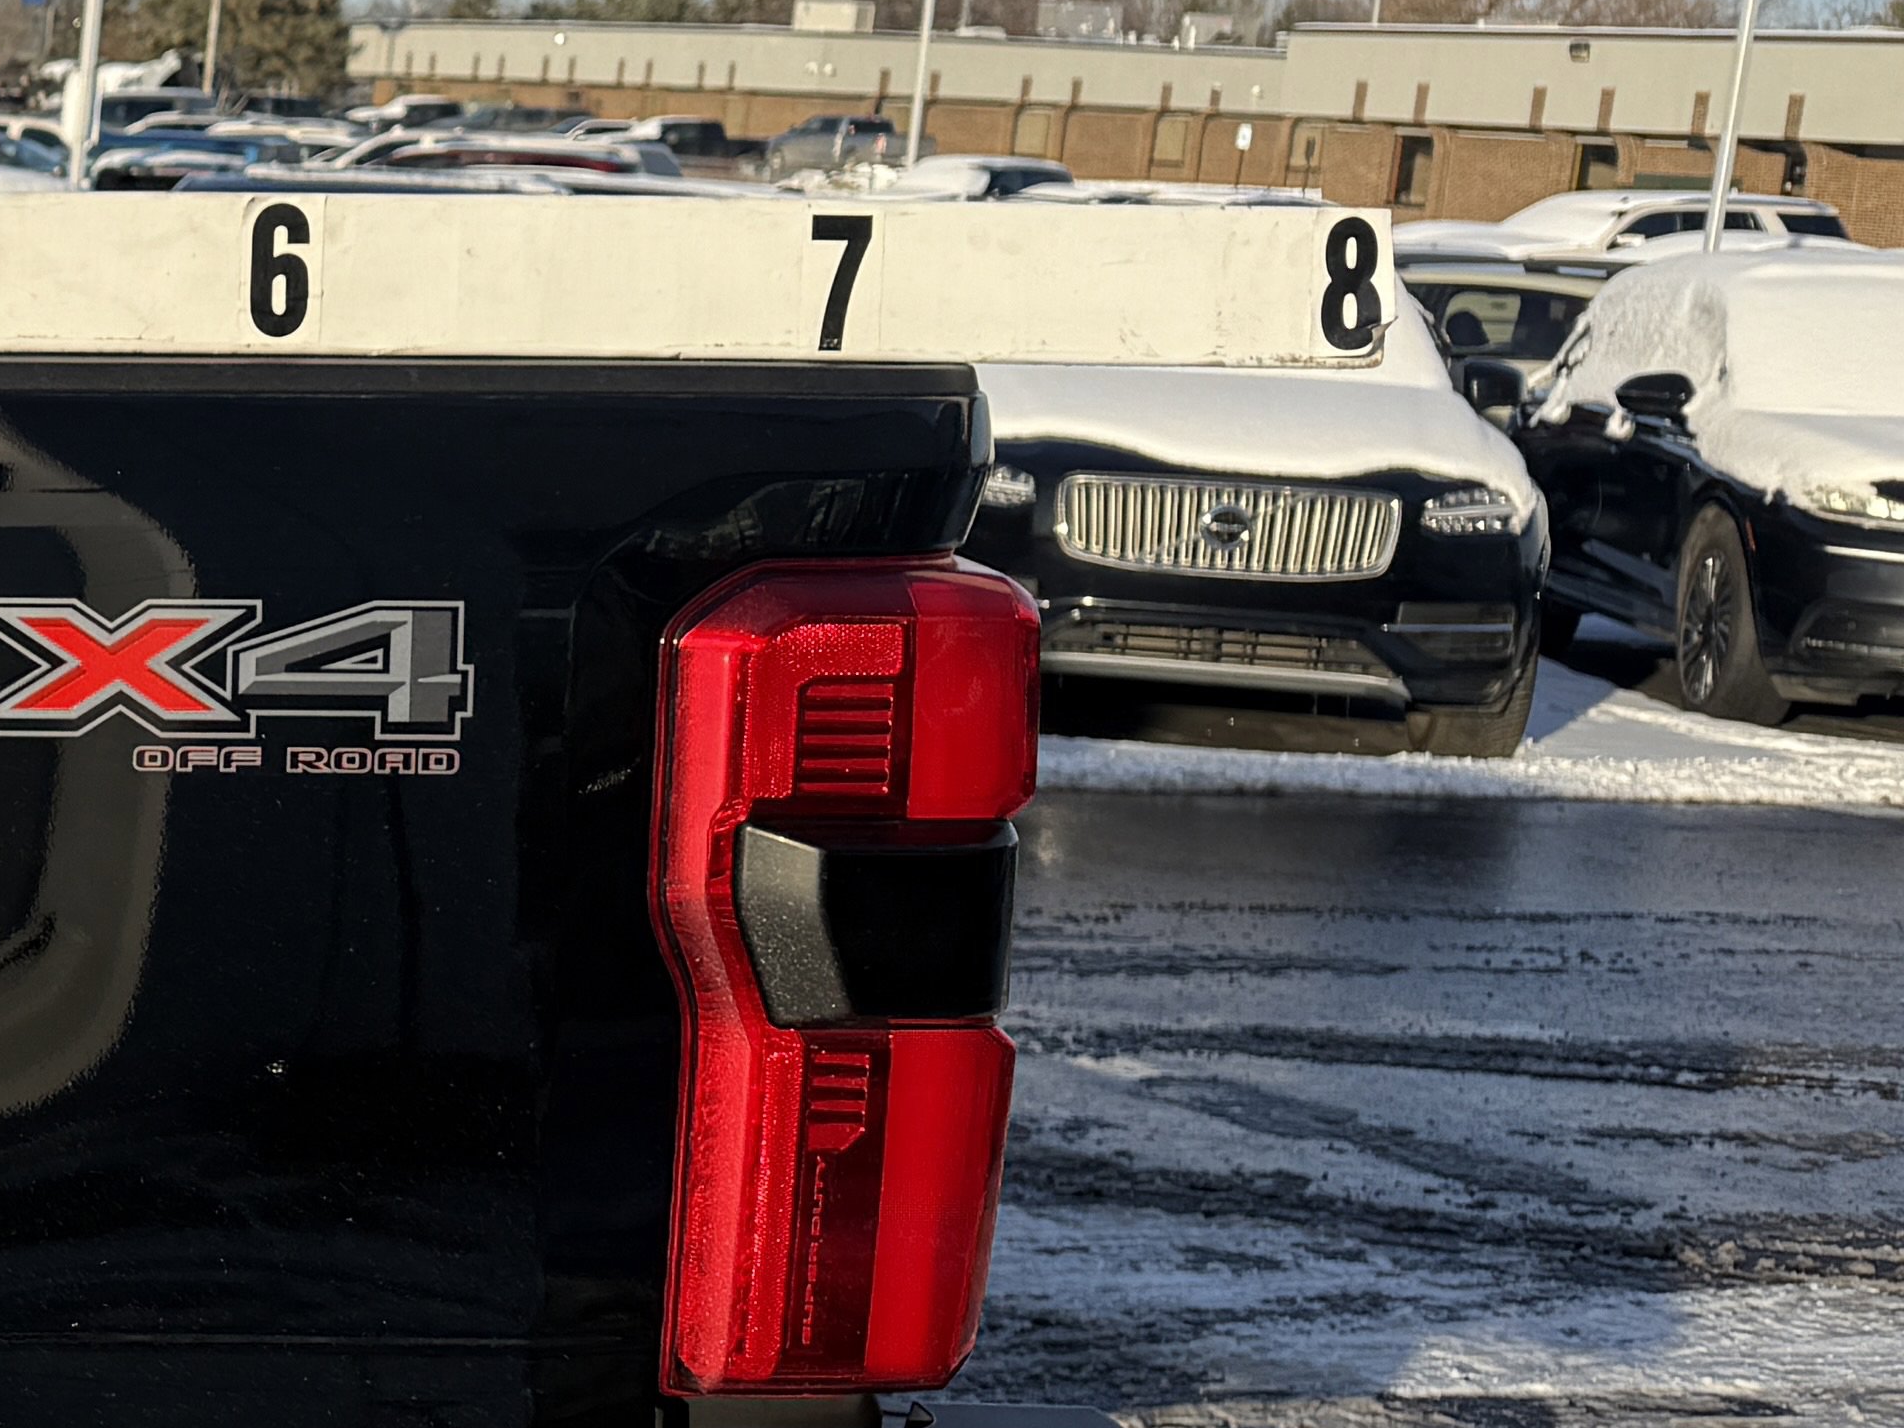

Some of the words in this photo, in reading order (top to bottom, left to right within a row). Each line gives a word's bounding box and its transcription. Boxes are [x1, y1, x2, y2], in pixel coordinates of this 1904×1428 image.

[249, 203, 310, 338] 6
[811, 214, 873, 351] 7
[1320, 216, 1382, 351] 8
[132, 744, 262, 773] OFF
[286, 746, 461, 775] ROAD
[802, 1243, 818, 1345] SUPER
[812, 1155, 826, 1236] DUTY
